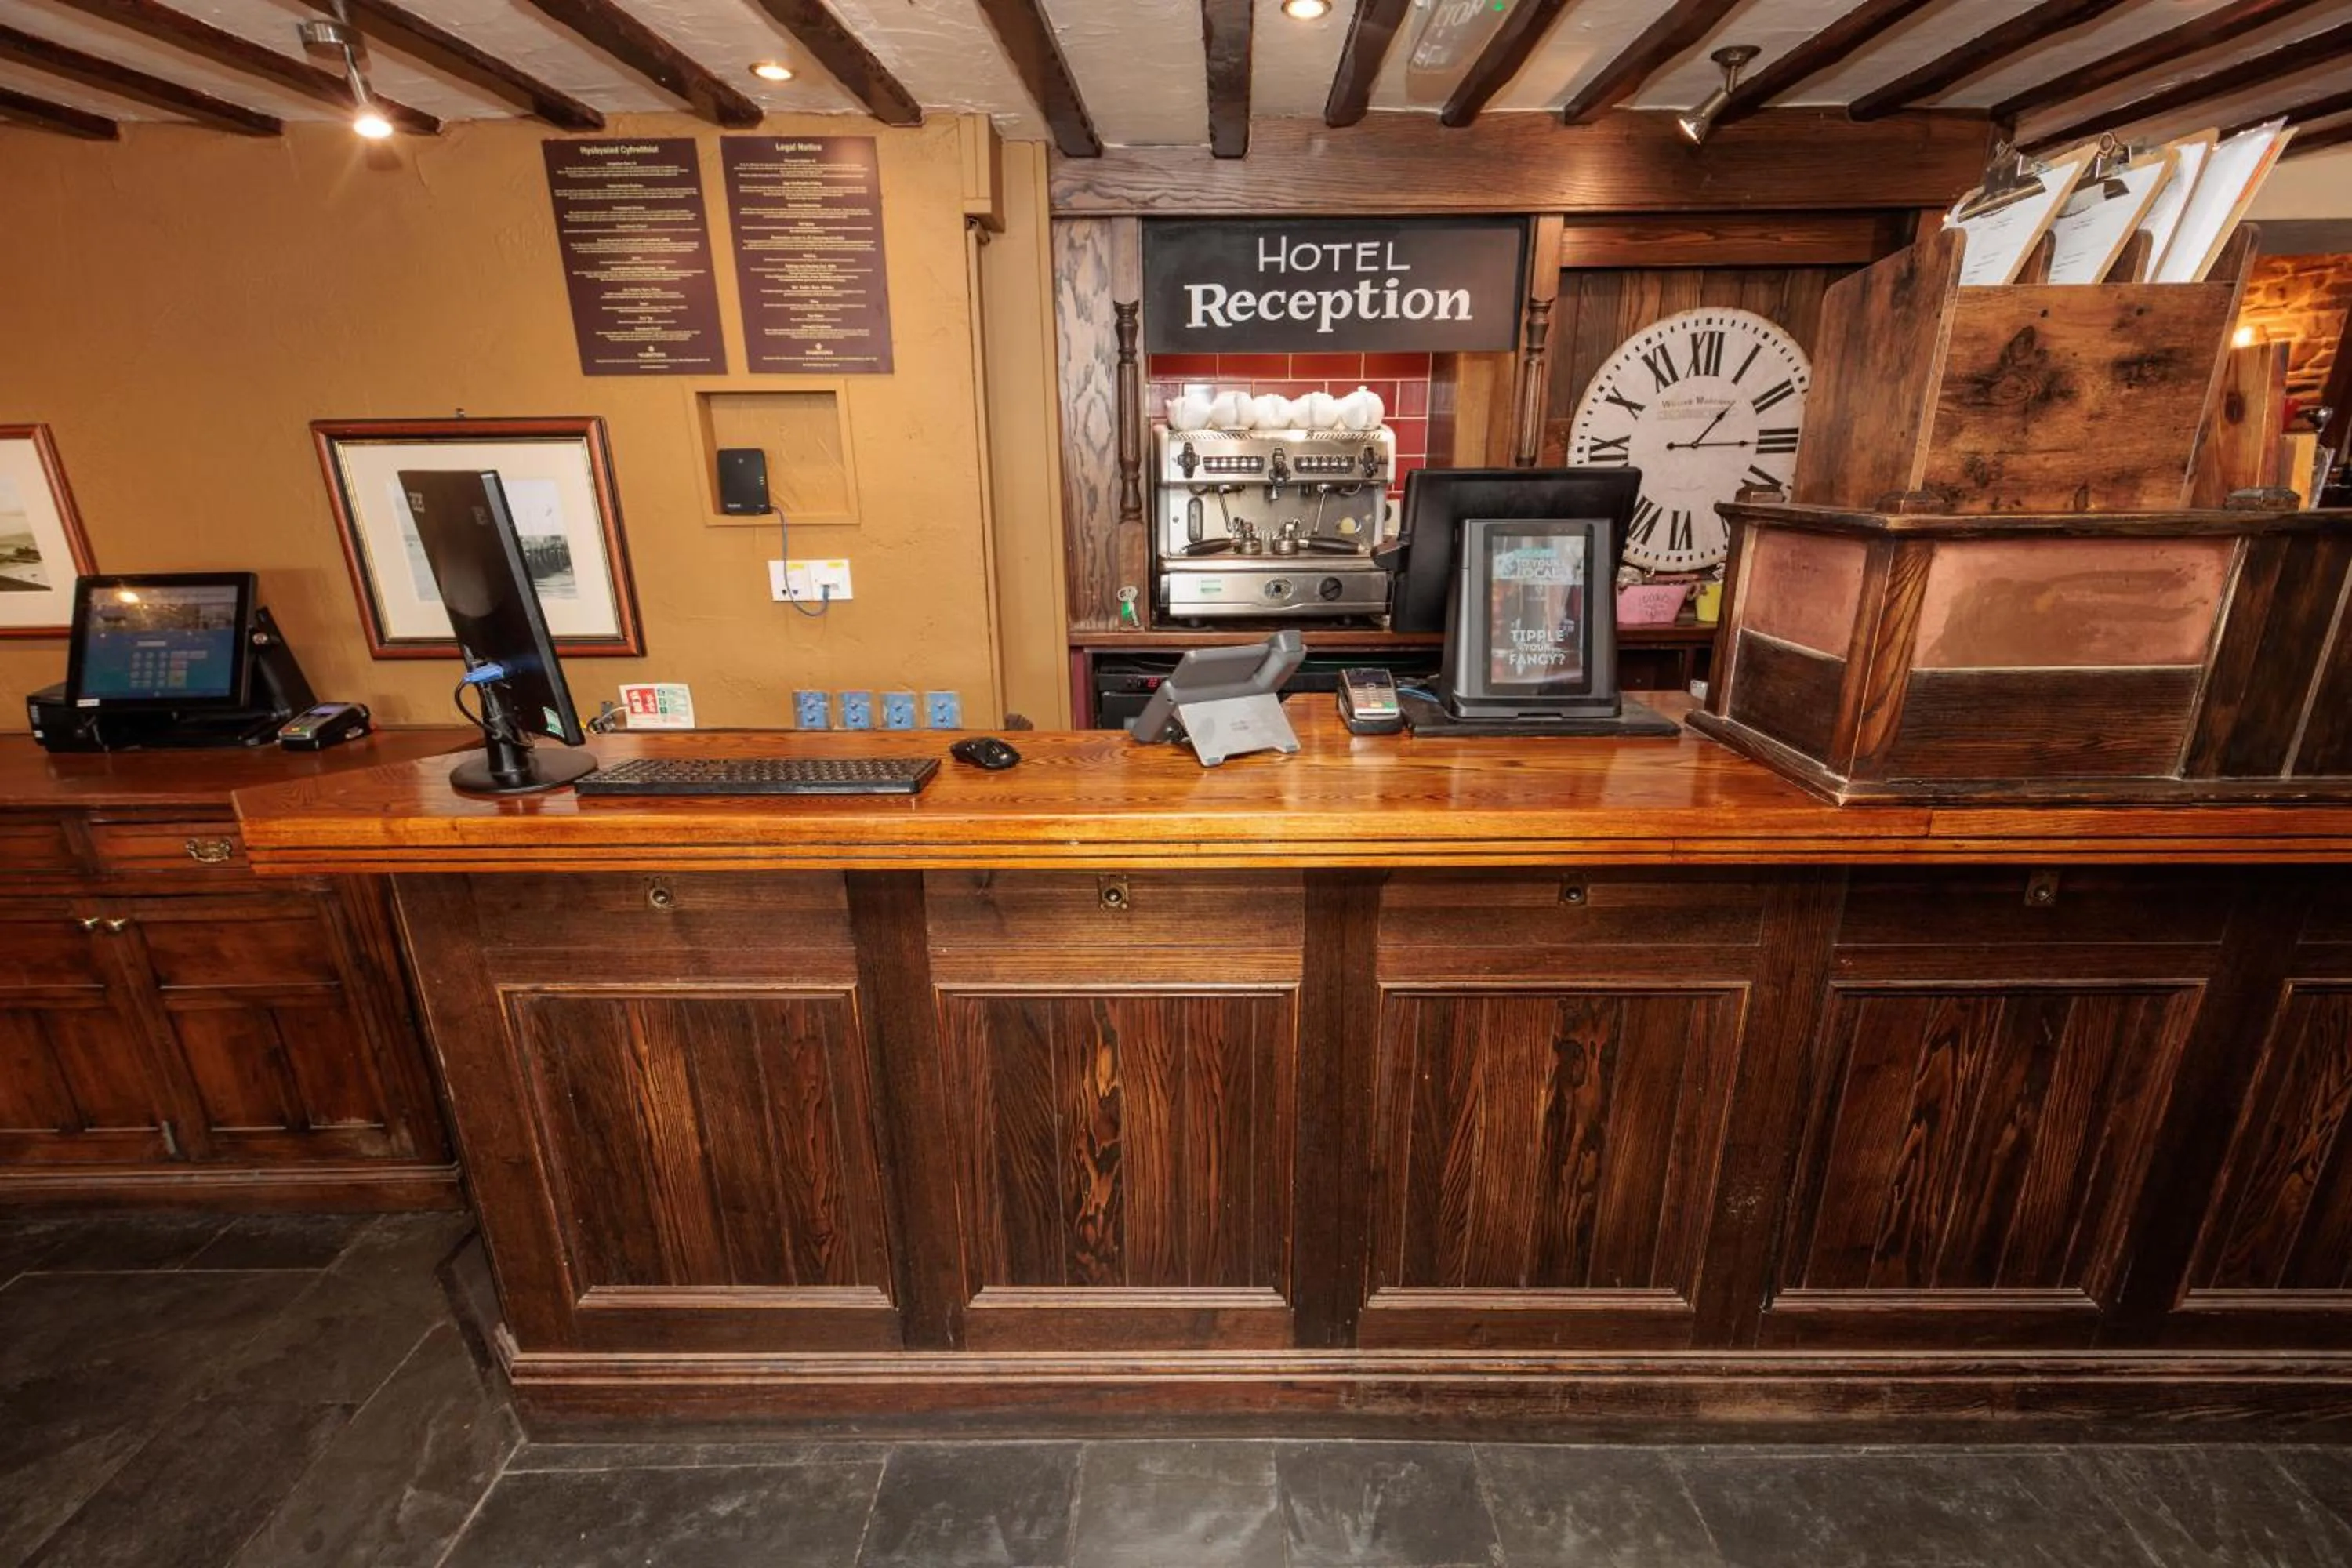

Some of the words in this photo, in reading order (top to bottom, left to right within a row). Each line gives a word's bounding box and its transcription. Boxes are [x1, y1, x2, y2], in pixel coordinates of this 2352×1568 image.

[775, 143, 796, 153] Legal
[1258, 235, 1410, 273] HOTEL
[1184, 277, 1473, 333] Reception
[1685, 331, 1726, 378] XII
[1510, 630, 1565, 642] TIPPLE
[1509, 654, 1566, 665] FANCY?
